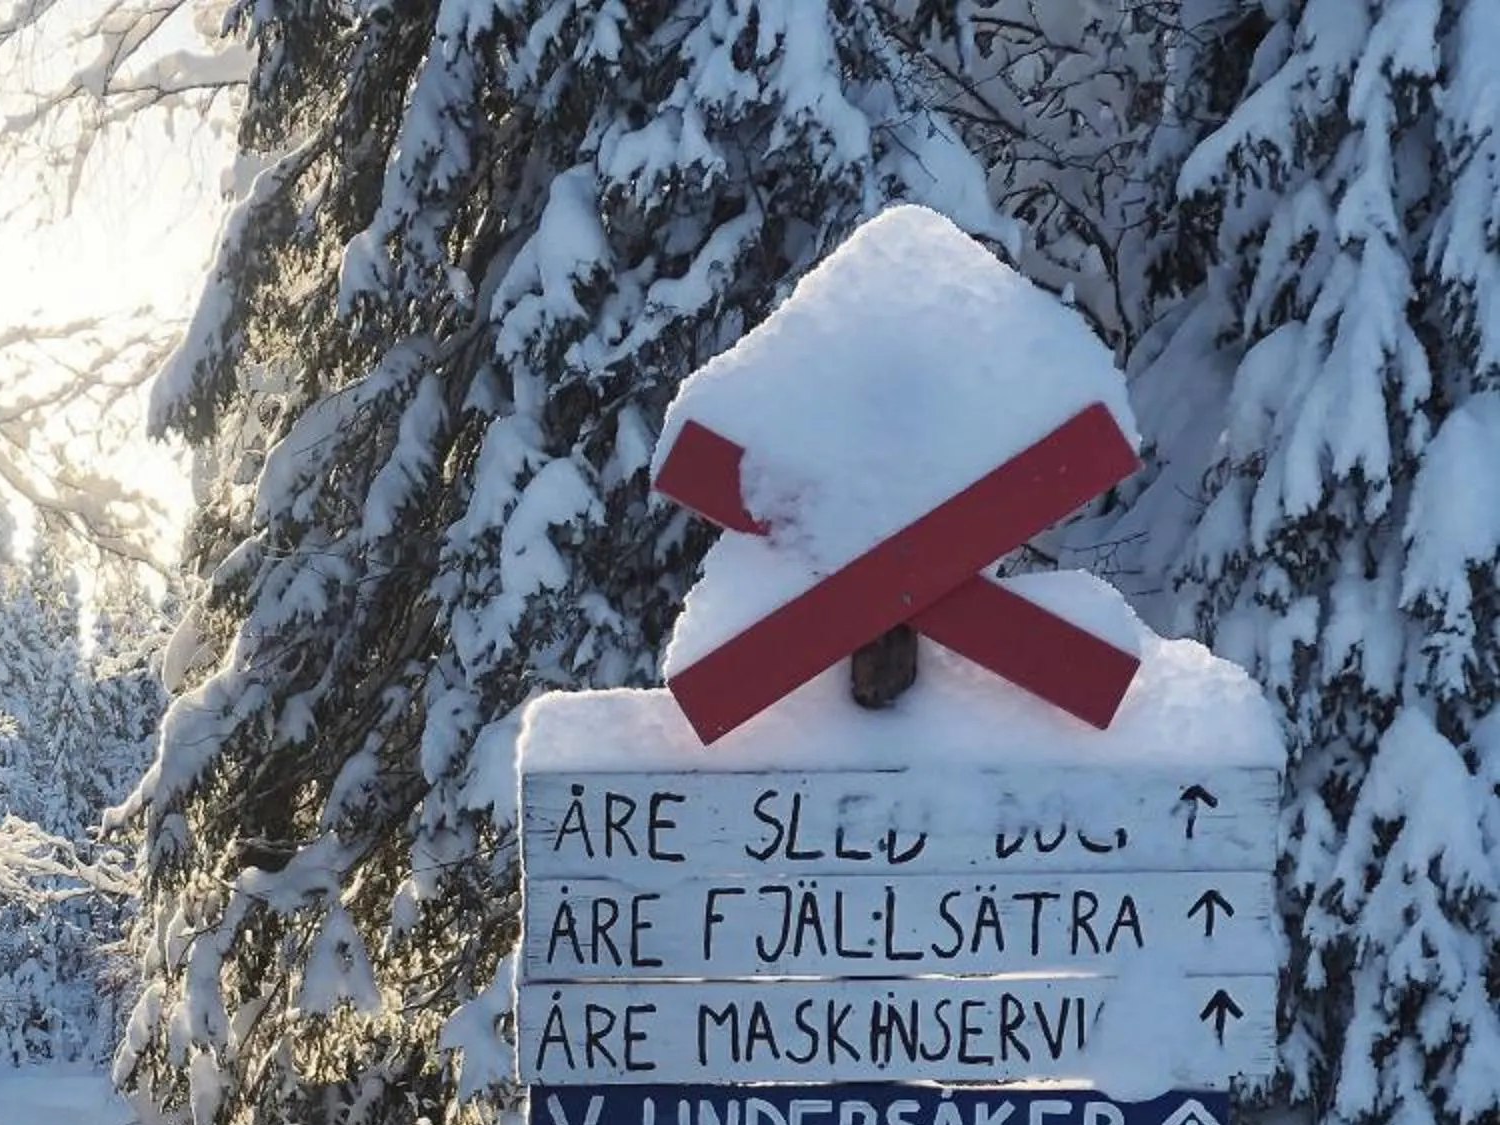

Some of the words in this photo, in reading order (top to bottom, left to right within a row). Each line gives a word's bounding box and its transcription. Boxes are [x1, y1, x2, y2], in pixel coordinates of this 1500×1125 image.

[553, 783, 686, 862] ÅRE
[547, 884, 663, 967] ÅRE
[536, 990, 656, 1070] ÅRE
